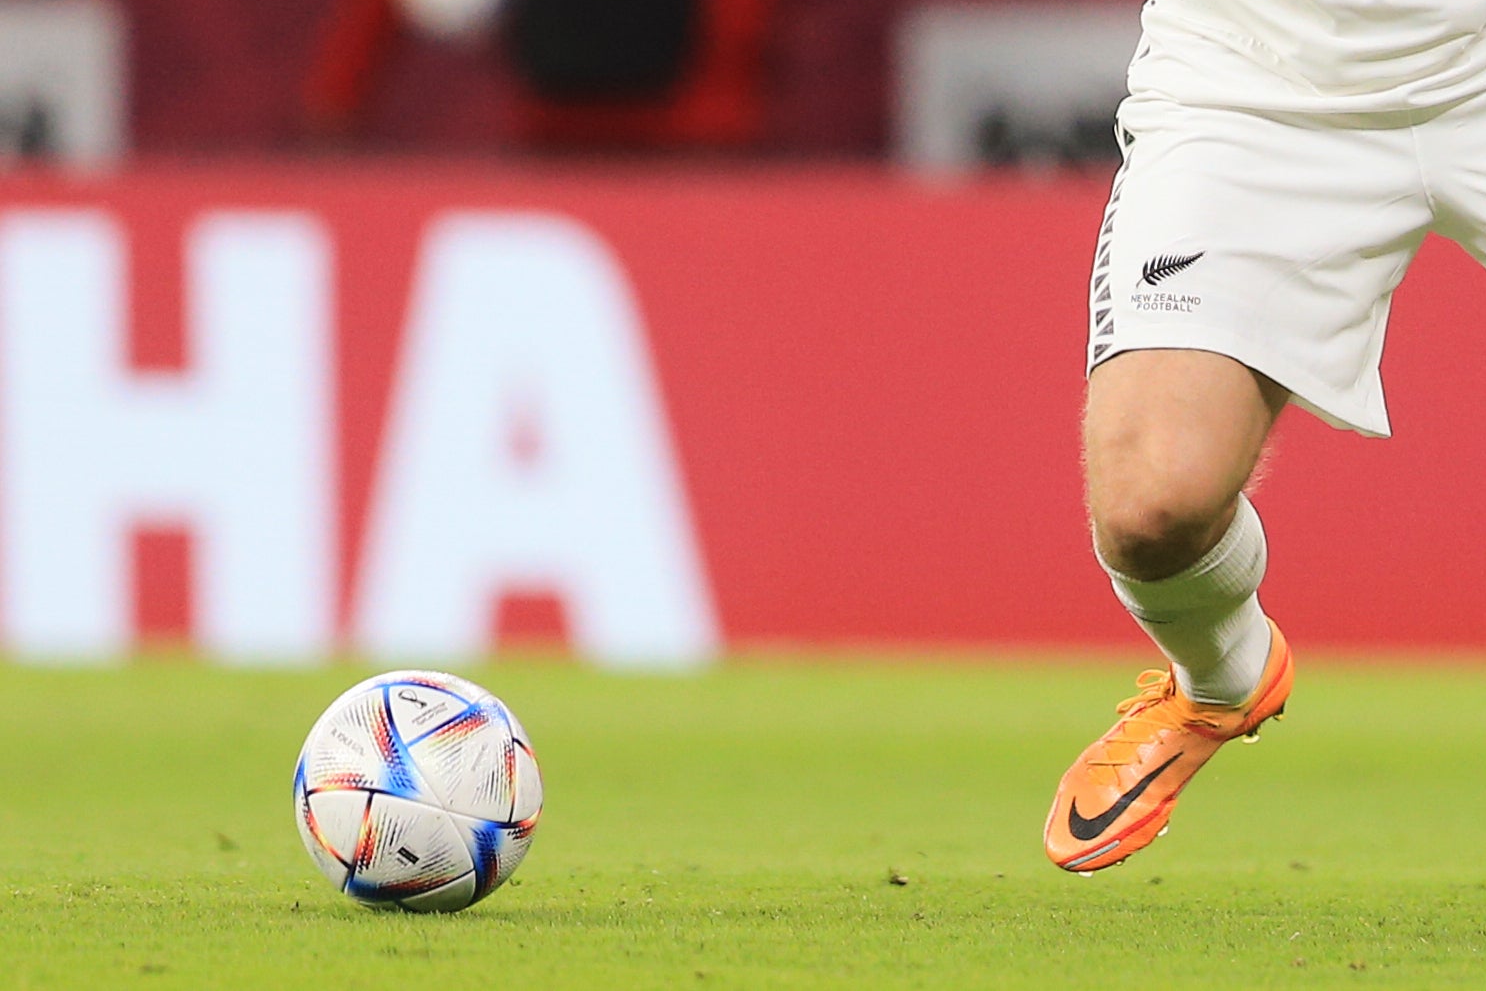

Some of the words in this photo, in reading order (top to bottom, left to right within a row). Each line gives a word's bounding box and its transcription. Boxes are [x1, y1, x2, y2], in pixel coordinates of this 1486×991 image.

[1130, 293, 1152, 303] NEW
[1153, 293, 1202, 306] ZEALAND
[1136, 302, 1193, 313] FOOTBALL
